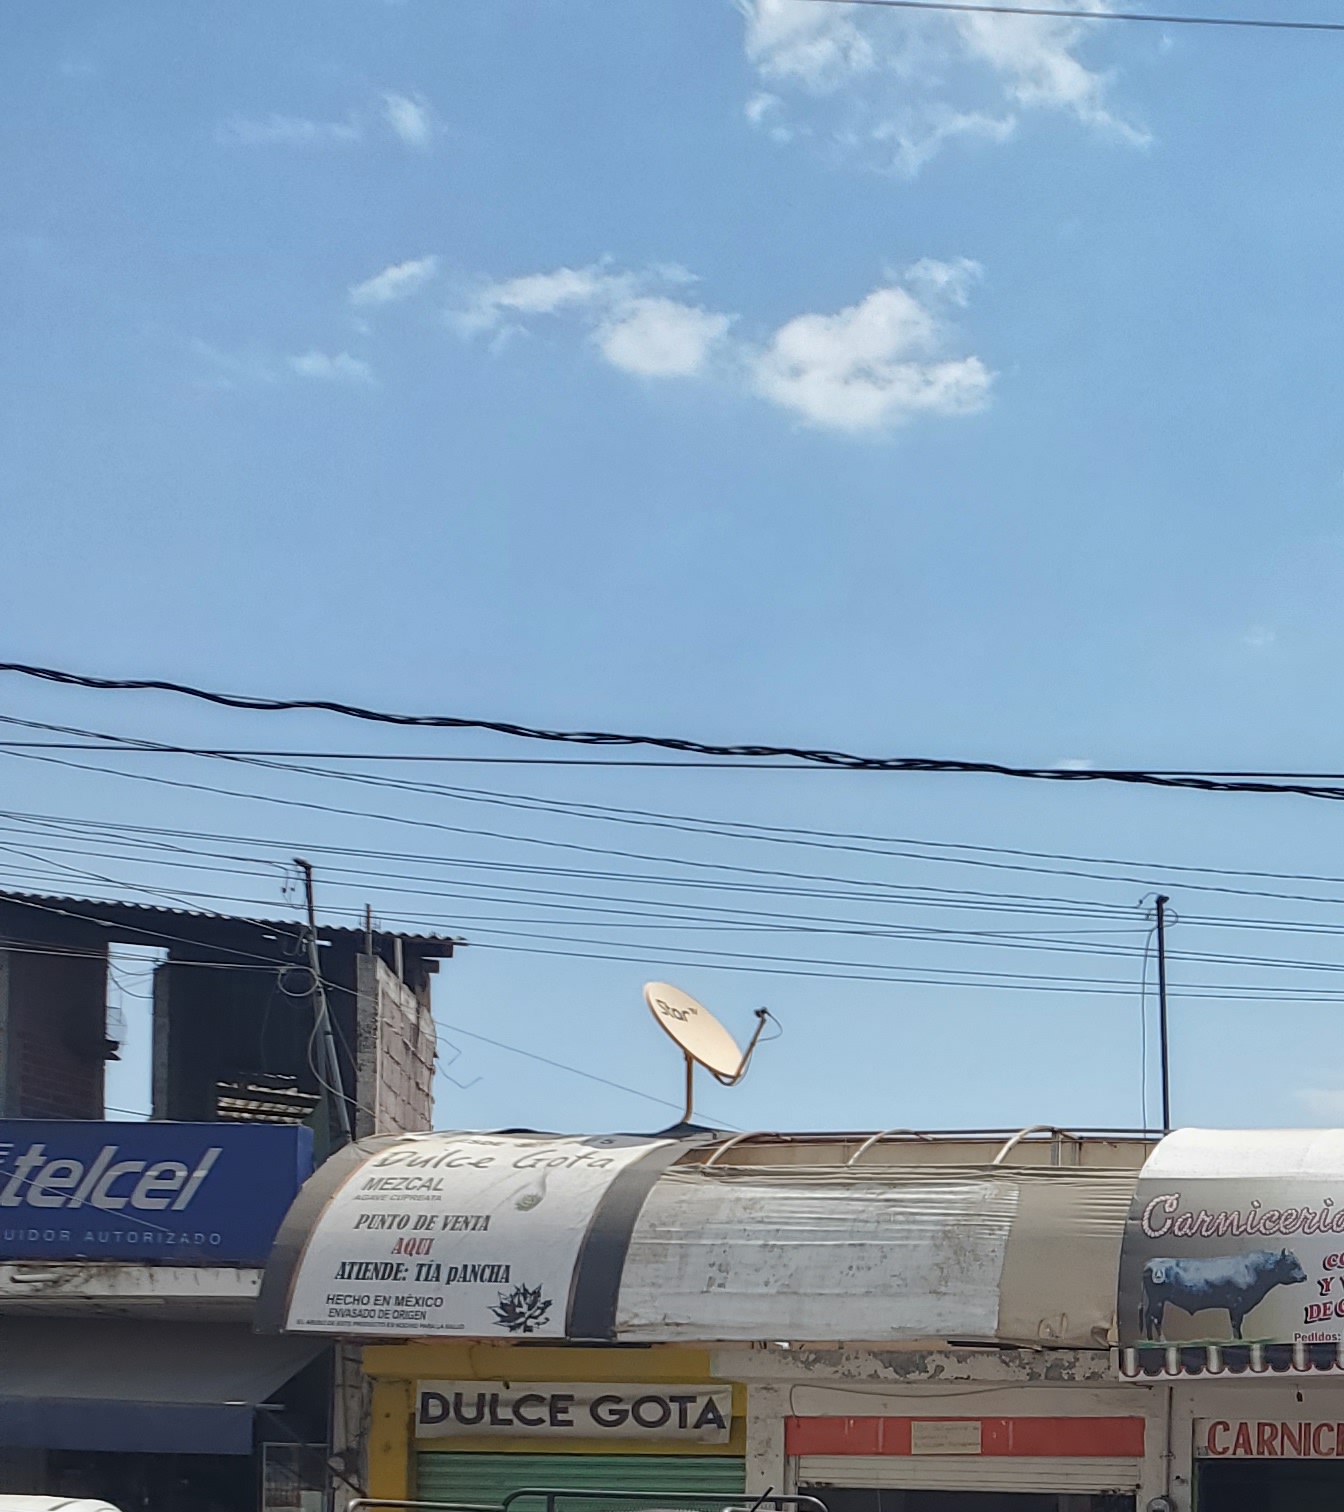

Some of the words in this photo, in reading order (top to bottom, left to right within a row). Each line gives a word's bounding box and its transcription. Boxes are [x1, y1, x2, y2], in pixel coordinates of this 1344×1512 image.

[372, 1149, 495, 1169] Dulce
[513, 1149, 615, 1170] Gota
[1, 1143, 223, 1211] telcel
[361, 1177, 445, 1192] MEZCAL
[353, 1213, 410, 1231] PUNTO
[411, 1214, 436, 1231] DE
[441, 1214, 492, 1232] VENTA
[84, 1231, 222, 1245] AUTORIZADO
[391, 1237, 435, 1258] AQUI
[334, 1261, 410, 1282] ATIENDE:
[415, 1260, 441, 1283] TÍA
[1319, 1277, 1334, 1296] Y
[325, 1294, 370, 1306] HECHO
[374, 1295, 391, 1306] EN
[394, 1293, 443, 1308] MÉXICO
[327, 1308, 376, 1319] ENVASADO
[378, 1309, 391, 1319] DE
[392, 1309, 427, 1320] ORIGEN
[1304, 1301, 1333, 1324] DE
[1294, 1331, 1341, 1342] Pedidos:
[419, 1391, 575, 1427] DULCE
[589, 1394, 728, 1429] GOTA
